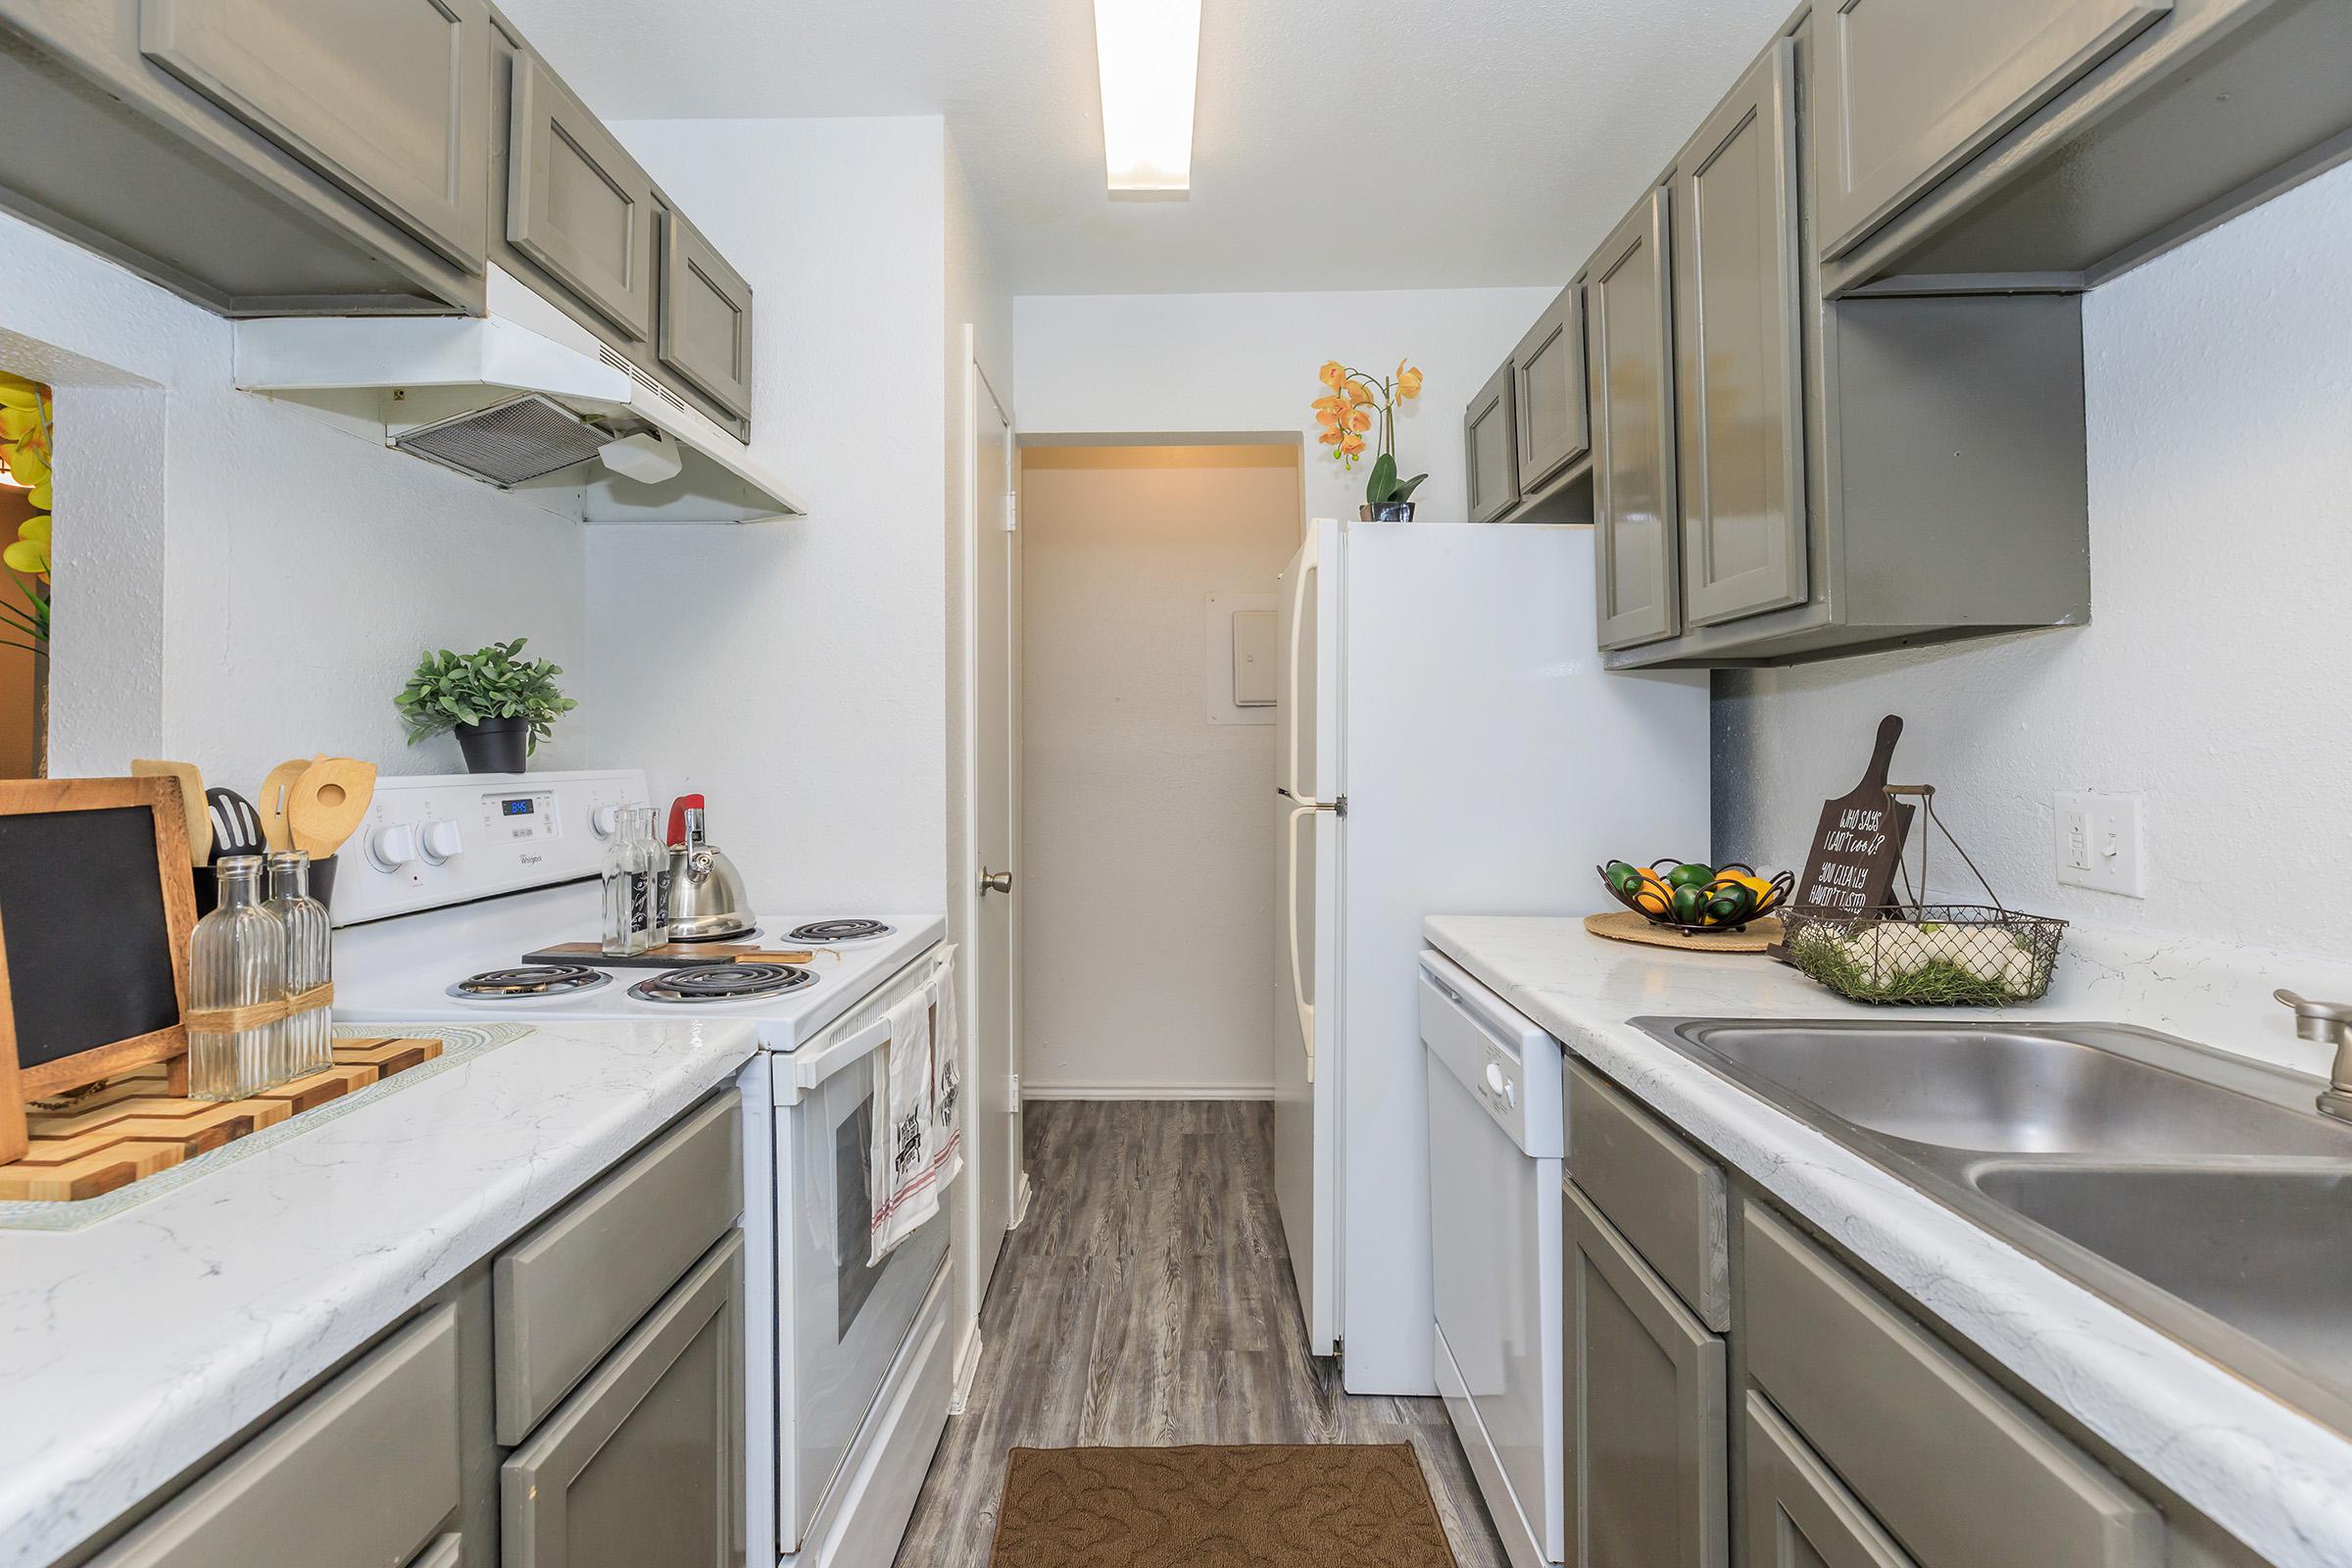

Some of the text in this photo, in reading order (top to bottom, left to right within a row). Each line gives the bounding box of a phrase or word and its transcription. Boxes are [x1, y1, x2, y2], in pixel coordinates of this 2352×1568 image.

[1839, 808, 1883, 832] WHO SAYS
[1828, 831, 1854, 853] CAN'T
[1818, 862, 1837, 883] YOU
[1808, 885, 1841, 906] HAVEN'T
